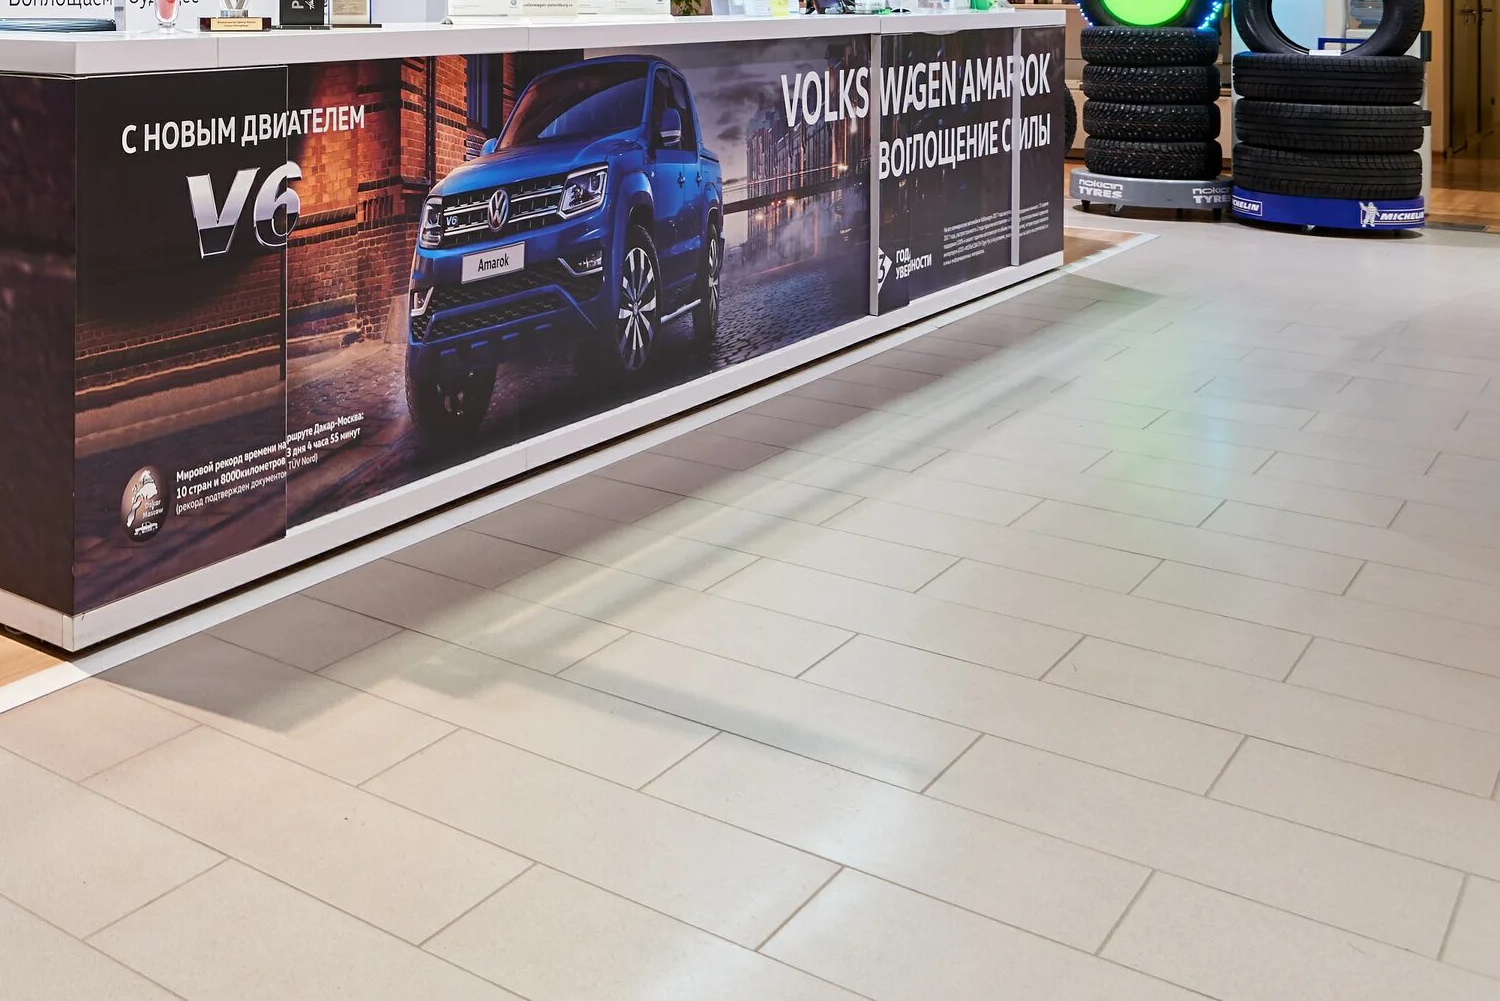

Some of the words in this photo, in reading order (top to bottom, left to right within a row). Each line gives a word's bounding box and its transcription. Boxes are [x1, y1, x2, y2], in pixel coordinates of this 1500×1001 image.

[122, 124, 137, 154] С
[144, 116, 236, 152] НОВЫМ
[1078, 186, 1122, 199] TYRES
[1079, 179, 1123, 191] nokian
[1192, 187, 1229, 195] nokia
[1193, 194, 1231, 204] TYRE
[186, 160, 302, 259] V6
[446, 215, 458, 227] V6
[477, 253, 510, 273] Amarok
[176, 485, 187, 499] 10
[188, 480, 212, 496] стран
[213, 478, 219, 487] и
[292, 444, 306, 457] дня
[307, 441, 312, 450] 4
[313, 437, 329, 449] часа
[330, 432, 339, 444] 55
[340, 427, 361, 439] минут
[176, 461, 214, 483] Мировой
[215, 454, 243, 472] рекорд
[244, 445, 277, 462] времени
[175, 500, 204, 515] (рекорд
[205, 484, 250, 504] подтвержден
[301, 453, 318, 466] Nord)
